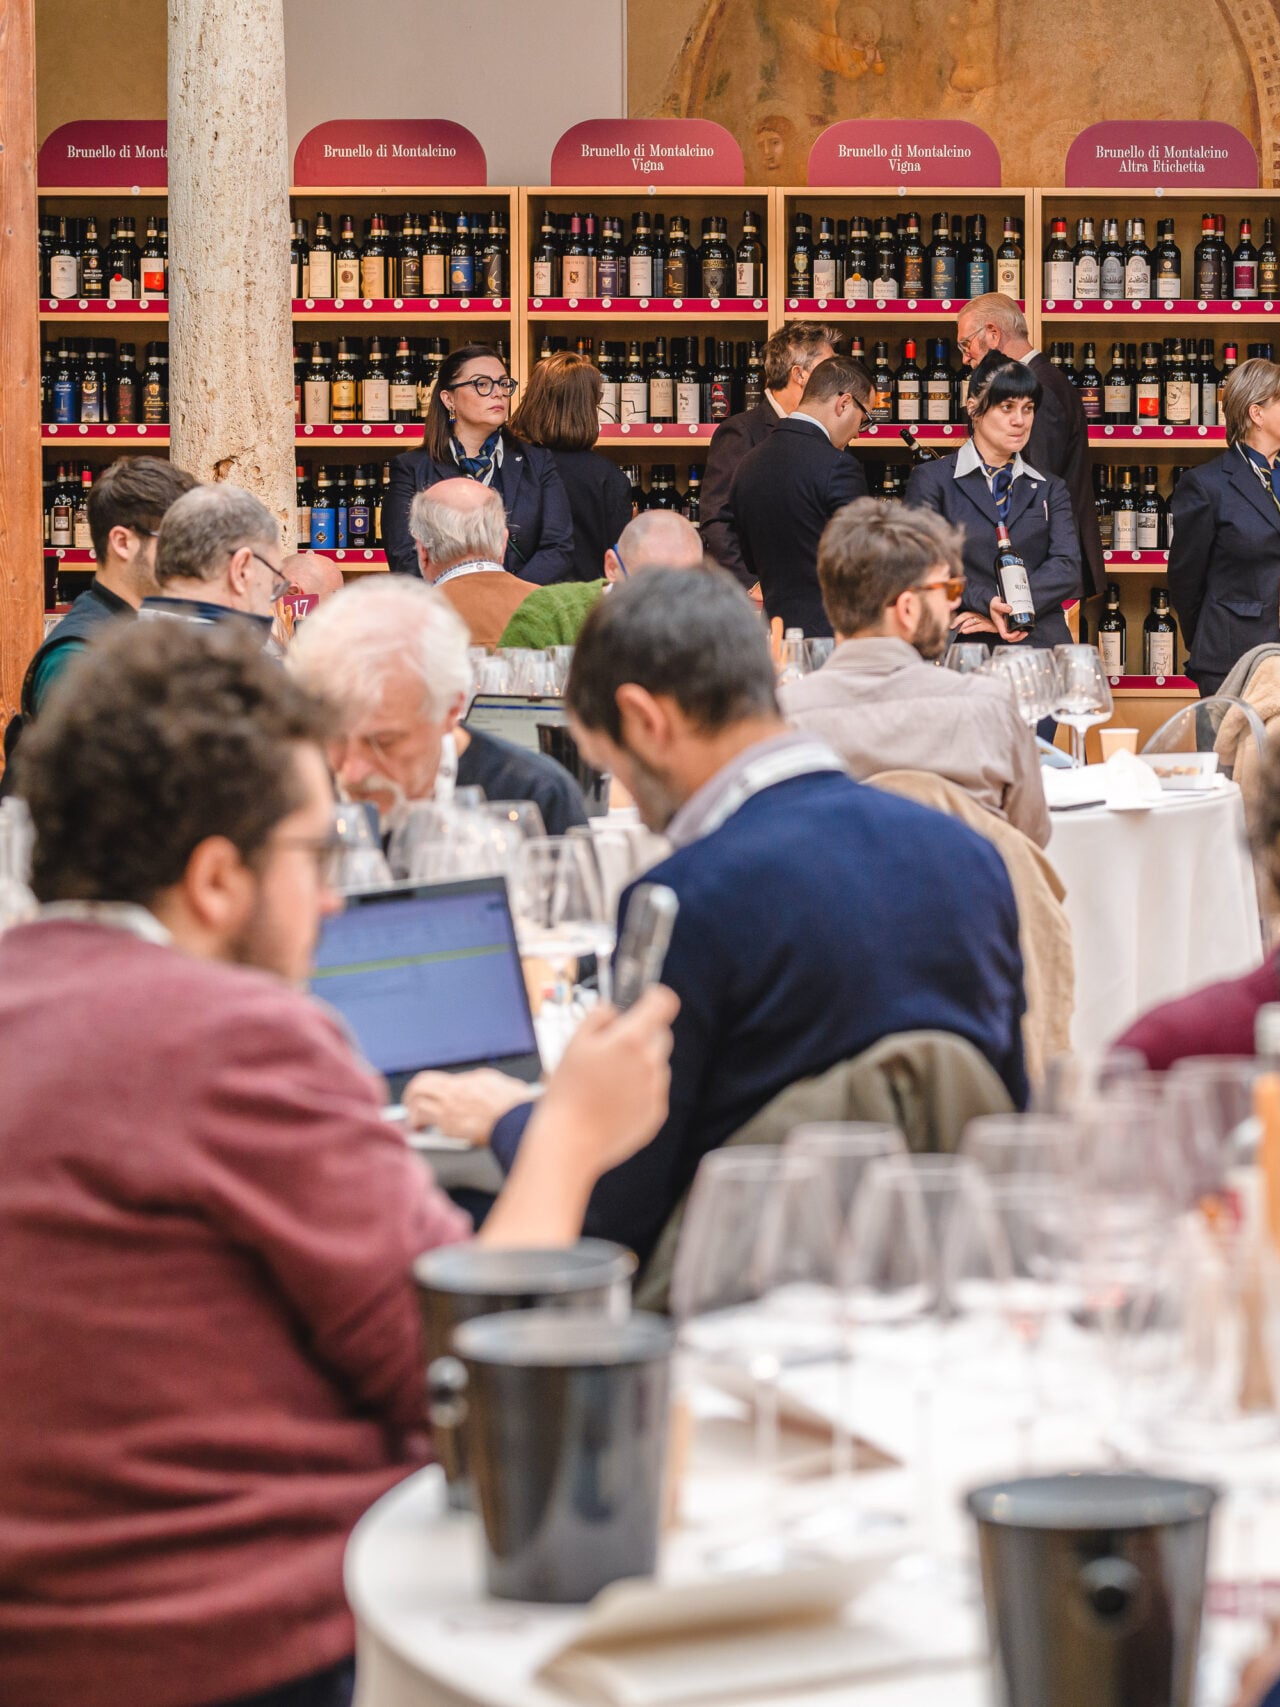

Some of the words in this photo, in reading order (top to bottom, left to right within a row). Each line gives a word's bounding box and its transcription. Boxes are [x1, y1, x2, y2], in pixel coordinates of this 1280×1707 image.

[67, 145, 116, 158] Brunello
[119, 145, 130, 158] di
[135, 145, 168, 158] Monta
[324, 144, 372, 157] Brunello
[376, 144, 388, 157] di
[392, 144, 456, 157] Montalcino
[582, 144, 630, 157] Brunello
[634, 144, 645, 157] di
[650, 144, 714, 157] Montalcino
[838, 144, 888, 157] Brunello
[891, 144, 902, 157] di
[907, 144, 972, 157] Montalcino
[1096, 146, 1144, 158] Brunello
[1148, 146, 1160, 158] di
[1164, 146, 1228, 158] Montalcino
[632, 158, 664, 173] Vigna
[889, 159, 921, 174] Vigna
[1119, 160, 1148, 173] Altra
[1153, 160, 1205, 173] Etichetta
[293, 600, 309, 616] 17
